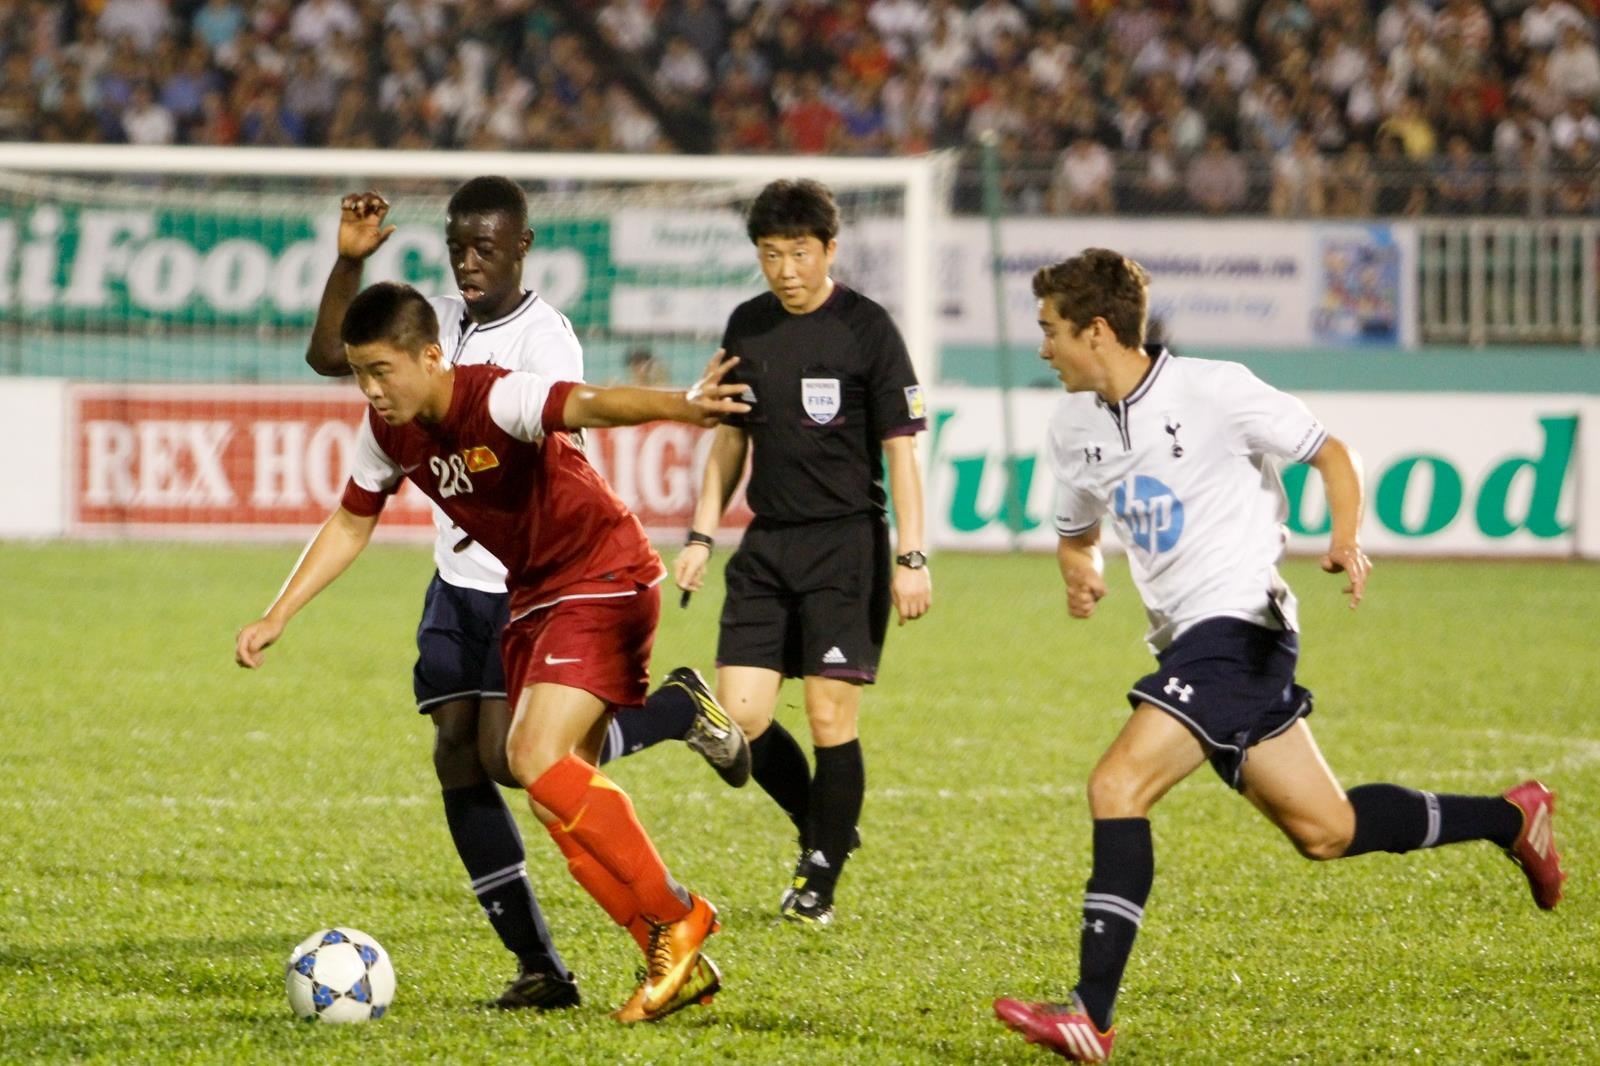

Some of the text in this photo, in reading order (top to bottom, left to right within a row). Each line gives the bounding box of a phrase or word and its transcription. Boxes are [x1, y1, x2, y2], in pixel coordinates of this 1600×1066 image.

[0, 204, 346, 312] iFood
[808, 396, 834, 405] FIFA
[85, 419, 235, 508] REX
[429, 453, 474, 499] 28
[1121, 470, 1174, 555] hp
